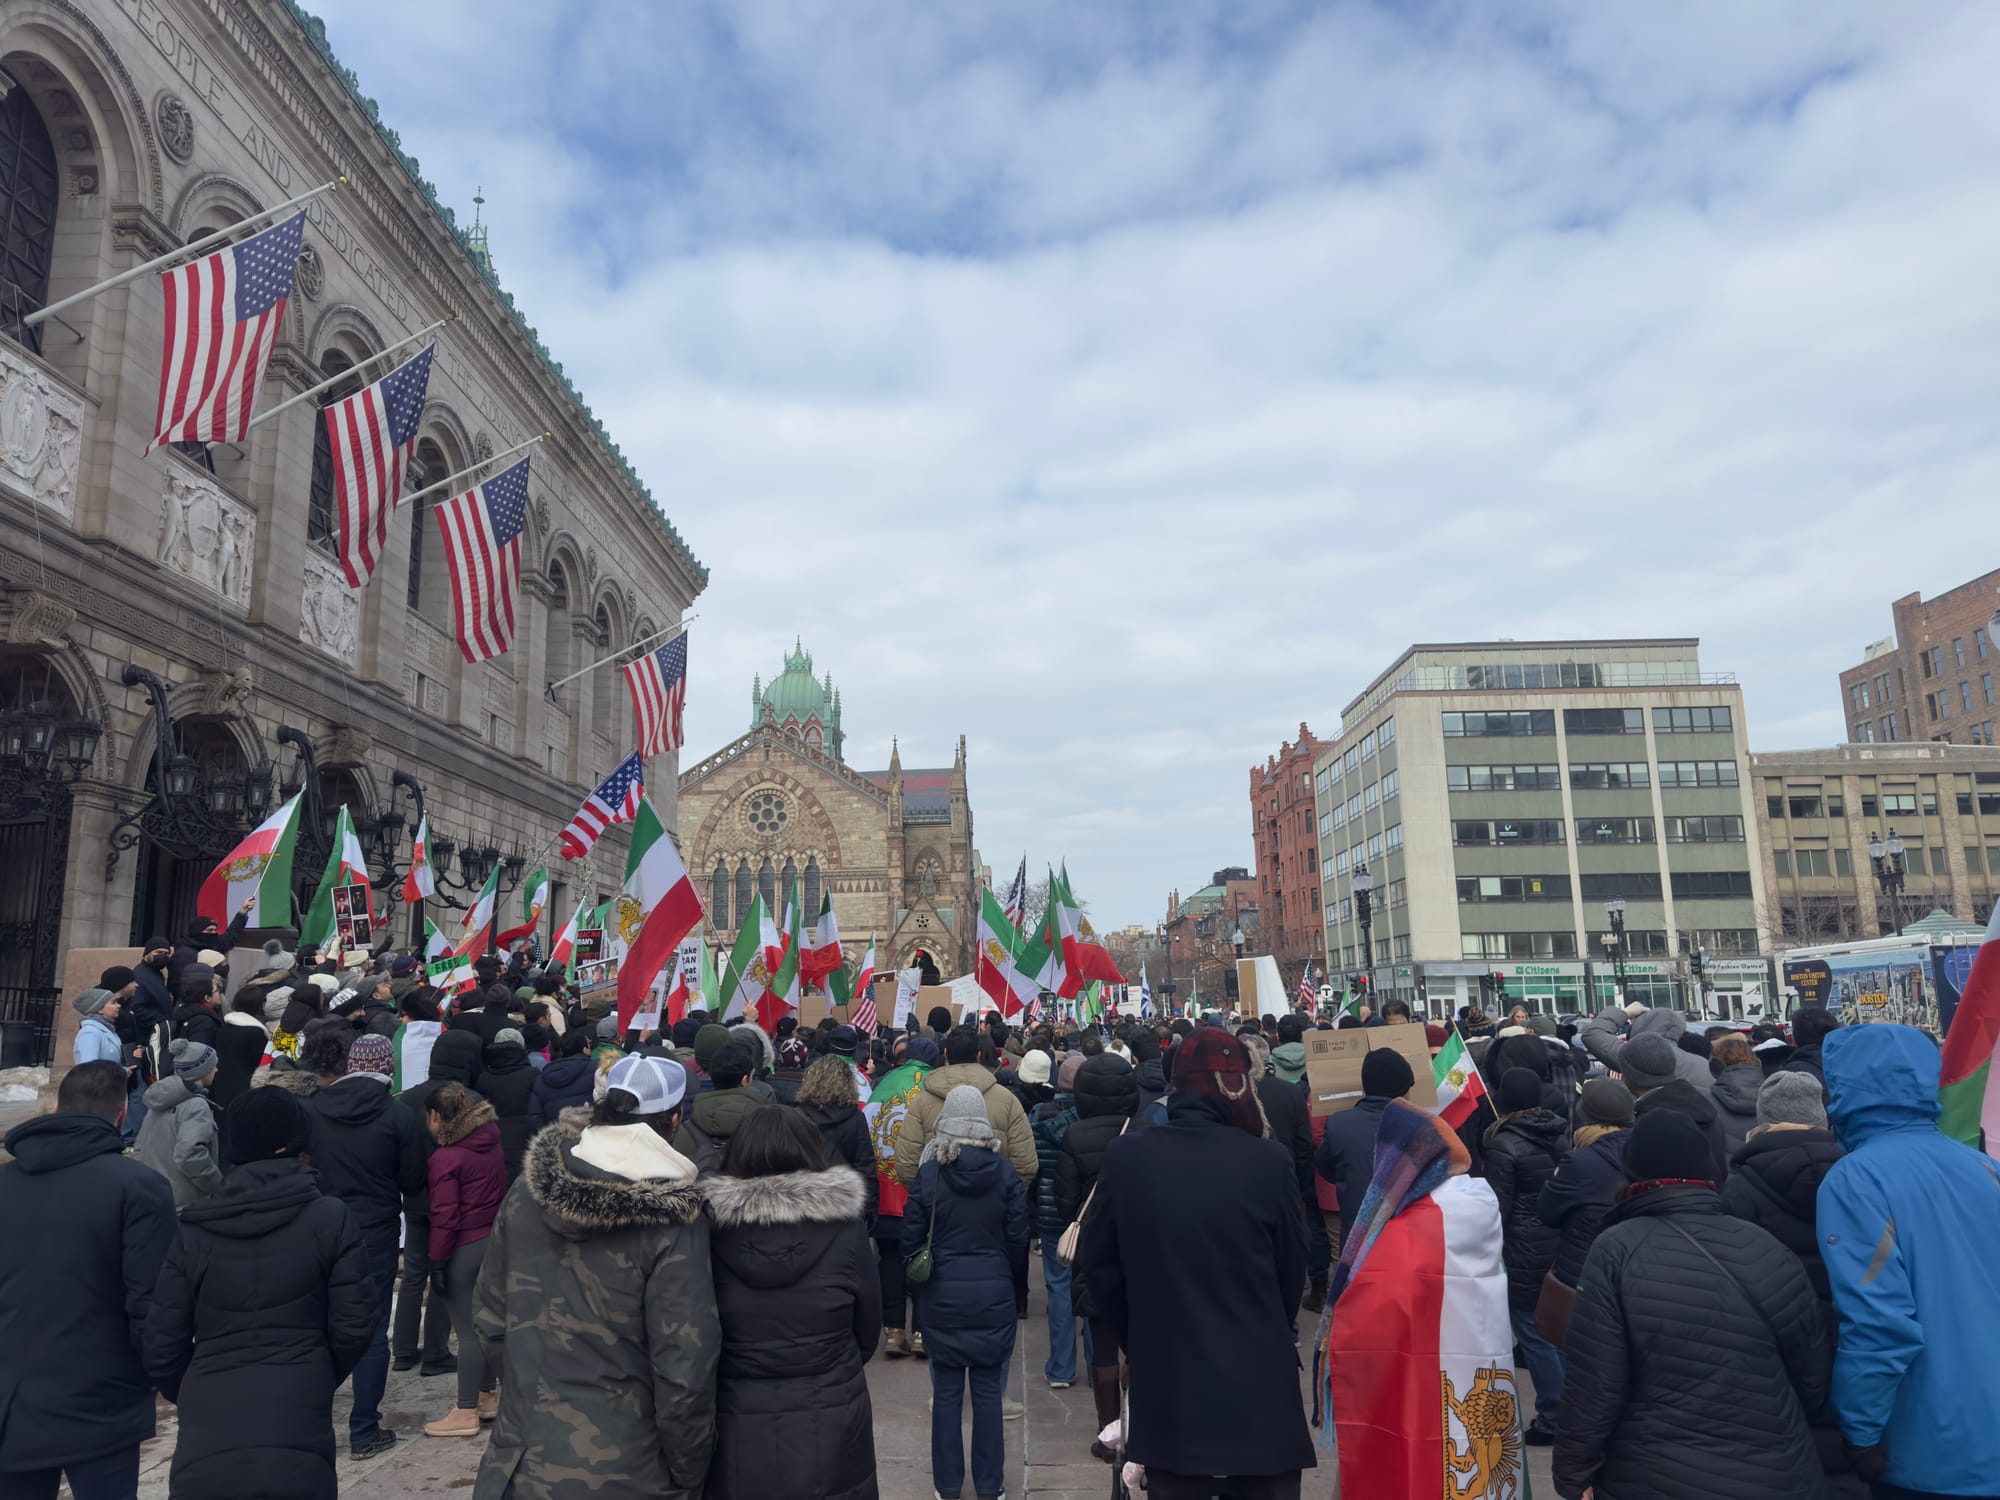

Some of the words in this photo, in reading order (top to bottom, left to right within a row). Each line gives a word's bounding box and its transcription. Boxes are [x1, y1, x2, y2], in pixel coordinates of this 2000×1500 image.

[117, 0, 224, 117] EOPLE
[243, 125, 291, 189] AND
[309, 199, 408, 322] DEDICATED
[448, 352, 473, 400] THE
[1524, 966, 1560, 975] Citizens
[1322, 988, 1331, 996] T
[1859, 993, 1888, 1008] BOSTON
